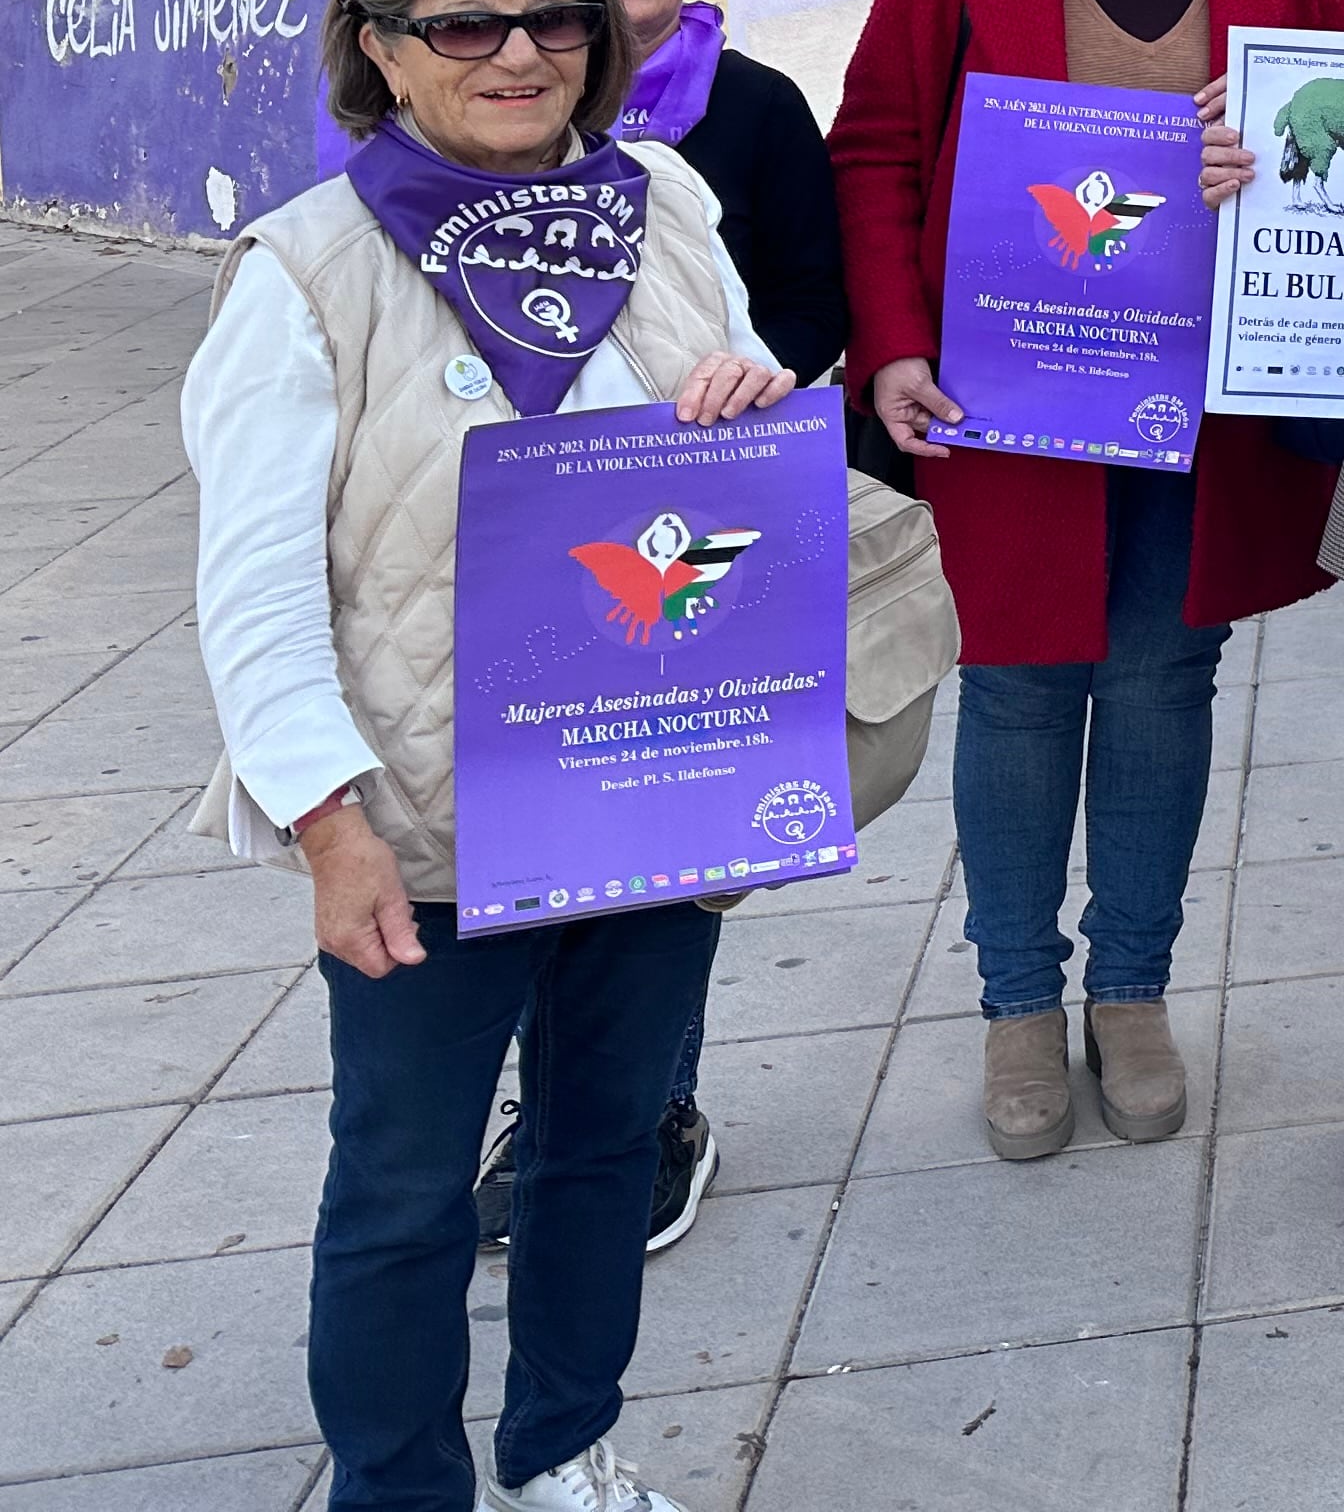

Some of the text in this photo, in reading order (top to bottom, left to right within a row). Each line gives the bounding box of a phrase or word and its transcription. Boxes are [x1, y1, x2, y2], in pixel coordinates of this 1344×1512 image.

[420, 183, 589, 275] Feministas
[597, 183, 635, 226] 8M
[1241, 270, 1278, 297] EL
[1012, 317, 1158, 345] MARCHA NOCTURNA
[1238, 315, 1274, 327] Detrás
[1276, 317, 1290, 328] de
[1292, 318, 1318, 329] cada
[1237, 331, 1286, 342] violencia
[1288, 332, 1302, 343] de
[1304, 334, 1341, 346] género
[523, 442, 555, 458] JAÉN
[558, 439, 587, 454] 2023.
[589, 435, 612, 451] DÍA
[615, 428, 716, 450] INTERNACIONAL
[717, 427, 733, 441] DE
[734, 425, 752, 440] LA
[753, 415, 827, 437] ELIMINACIÓN
[555, 444, 780, 475] DE LA VIOLENCIA CONTRA LA MUJER.
[500, 669, 825, 724] "Mujeres Asesinadas y Olvidadas."
[561, 704, 770, 746] MARCHA NOCTURNA
[557, 731, 773, 769] Viernes 24 de noviembre.18h.
[600, 776, 639, 791] Desde
[662, 771, 674, 782] S.
[677, 766, 736, 781] Ildefonso
